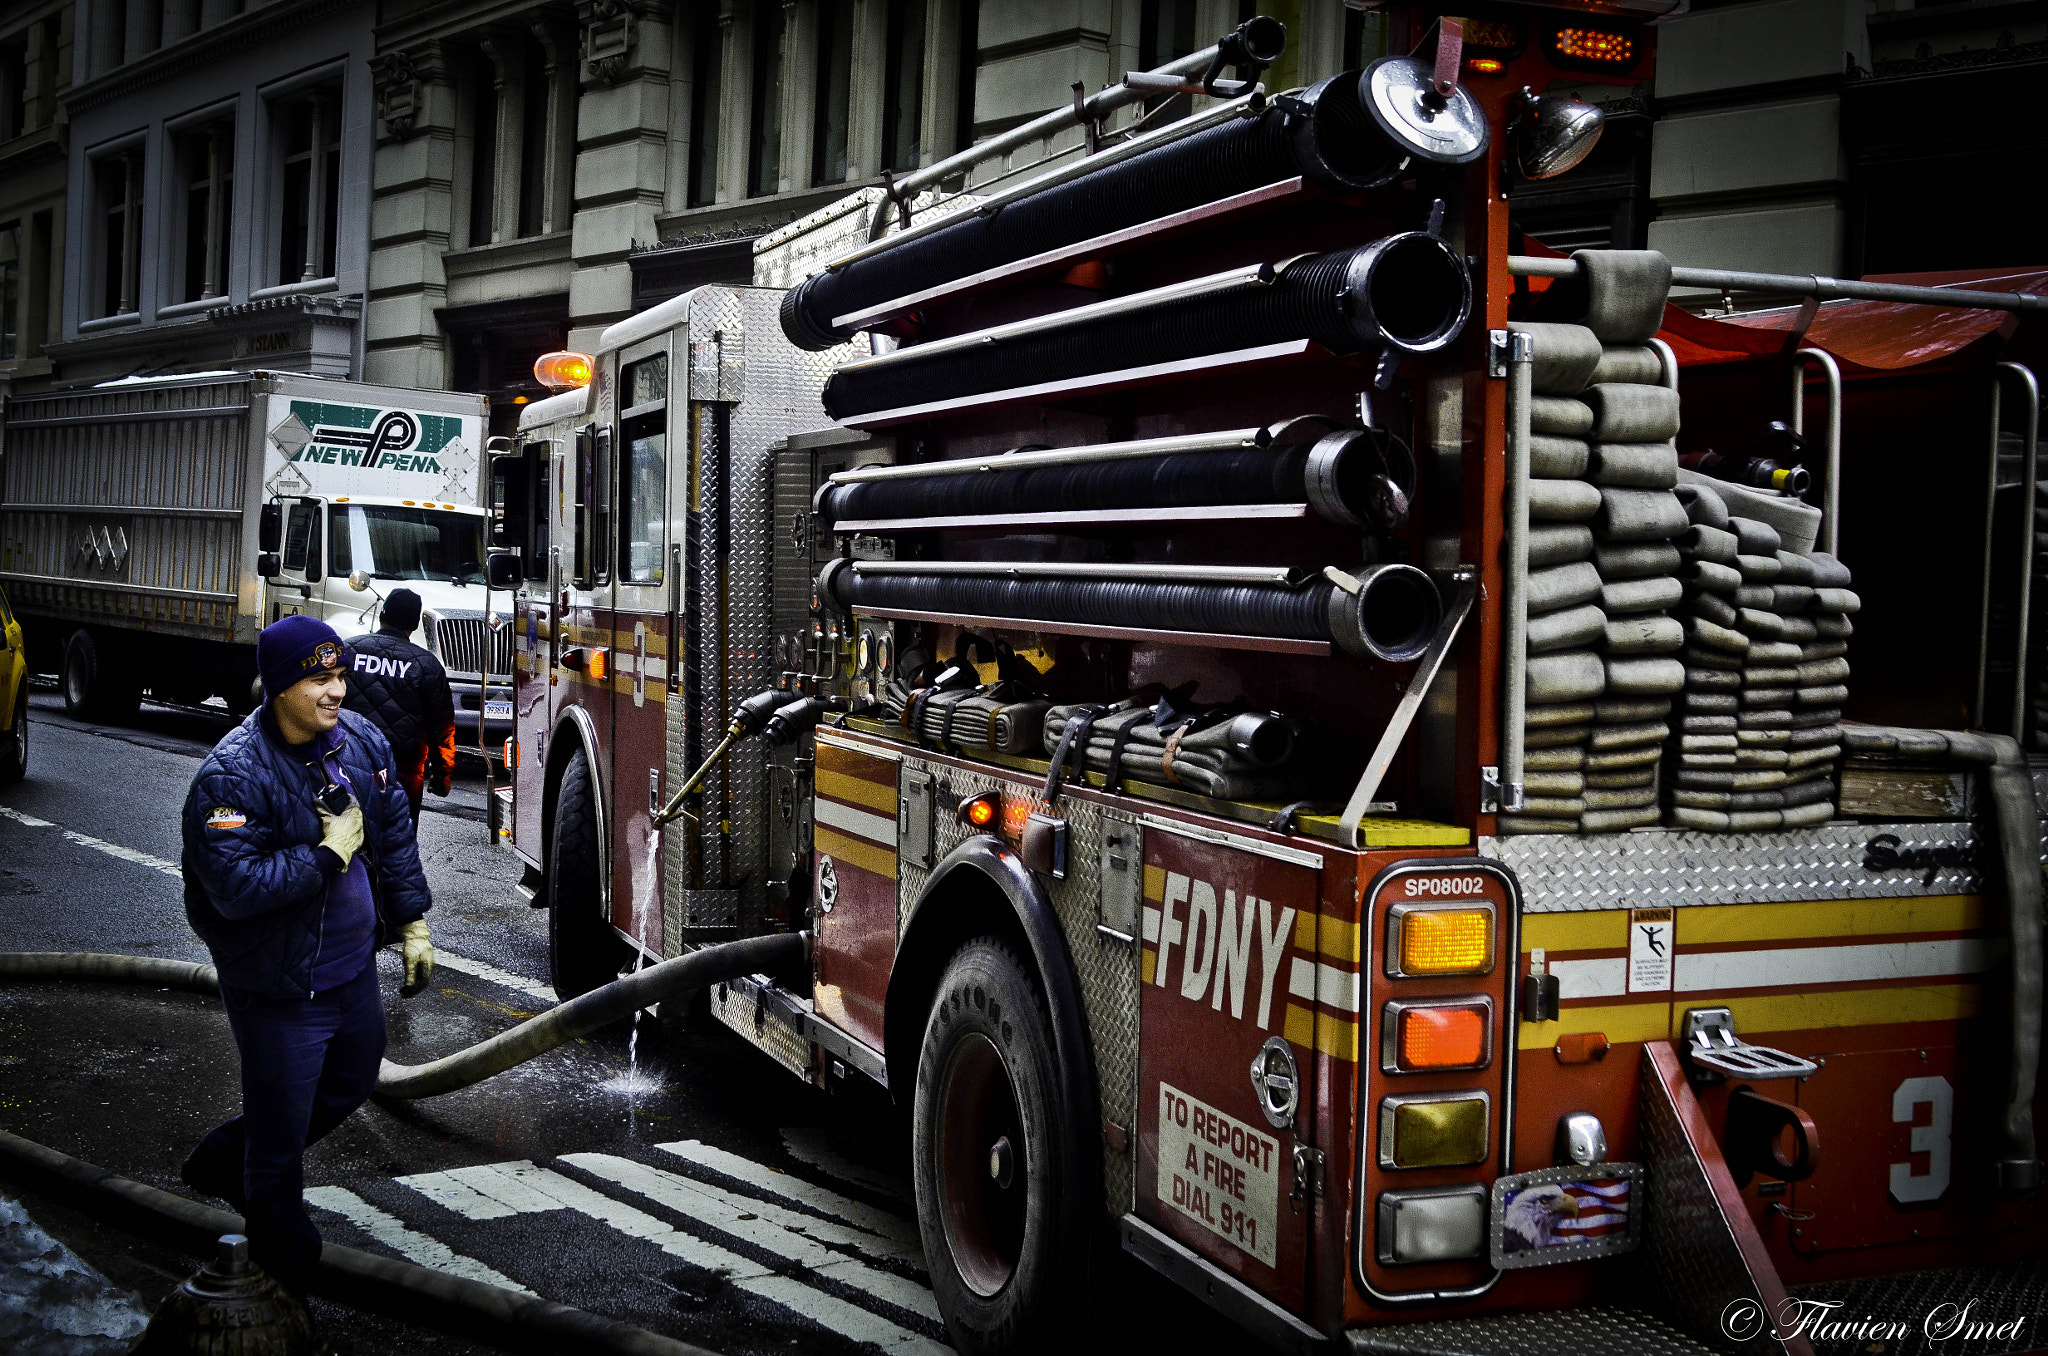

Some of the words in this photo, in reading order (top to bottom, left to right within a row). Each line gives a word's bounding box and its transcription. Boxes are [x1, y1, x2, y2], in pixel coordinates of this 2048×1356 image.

[304, 445, 363, 467] NEW
[353, 653, 412, 679] FDNY
[633, 621, 645, 708] 3
[1404, 876, 1484, 897] SP08002
[1640, 909, 1671, 921] WARNING
[1156, 870, 1296, 1031] FDNY
[1164, 1090, 1188, 1128] TO
[1193, 1105, 1273, 1173] REPORT
[1889, 1075, 1954, 1203] 3
[1185, 1143, 1199, 1176] A
[1204, 1151, 1245, 1202] FIRE
[1173, 1173, 1216, 1226] DIAL
[1221, 1202, 1257, 1250] 911
